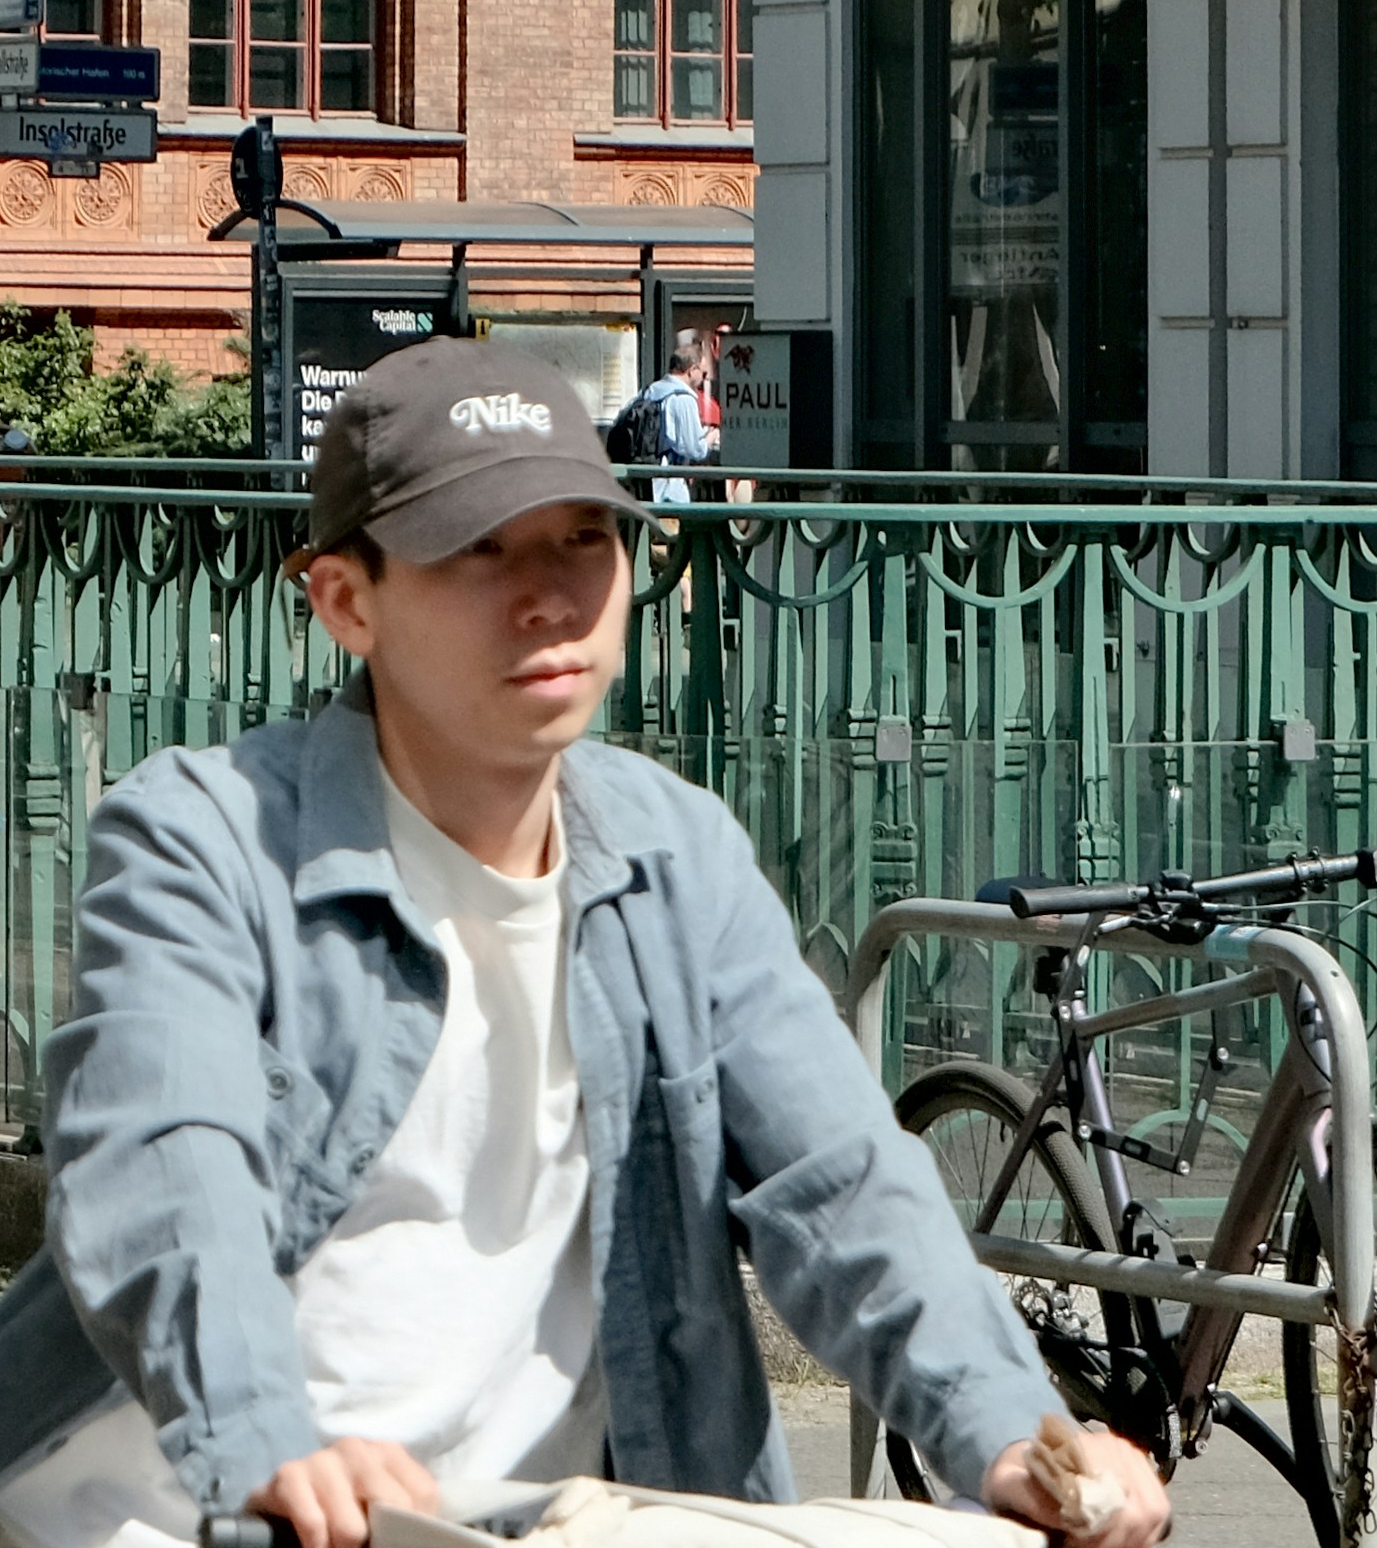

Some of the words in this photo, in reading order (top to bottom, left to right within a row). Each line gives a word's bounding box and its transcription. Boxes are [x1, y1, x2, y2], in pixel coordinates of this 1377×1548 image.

[19, 115, 128, 150] Inselstraße
[371, 309, 416, 324] Scalable
[379, 320, 416, 335] Capital
[300, 364, 367, 389] Warnu
[301, 389, 333, 413] Die
[726, 382, 788, 409] PAUL
[449, 392, 553, 435] Nike
